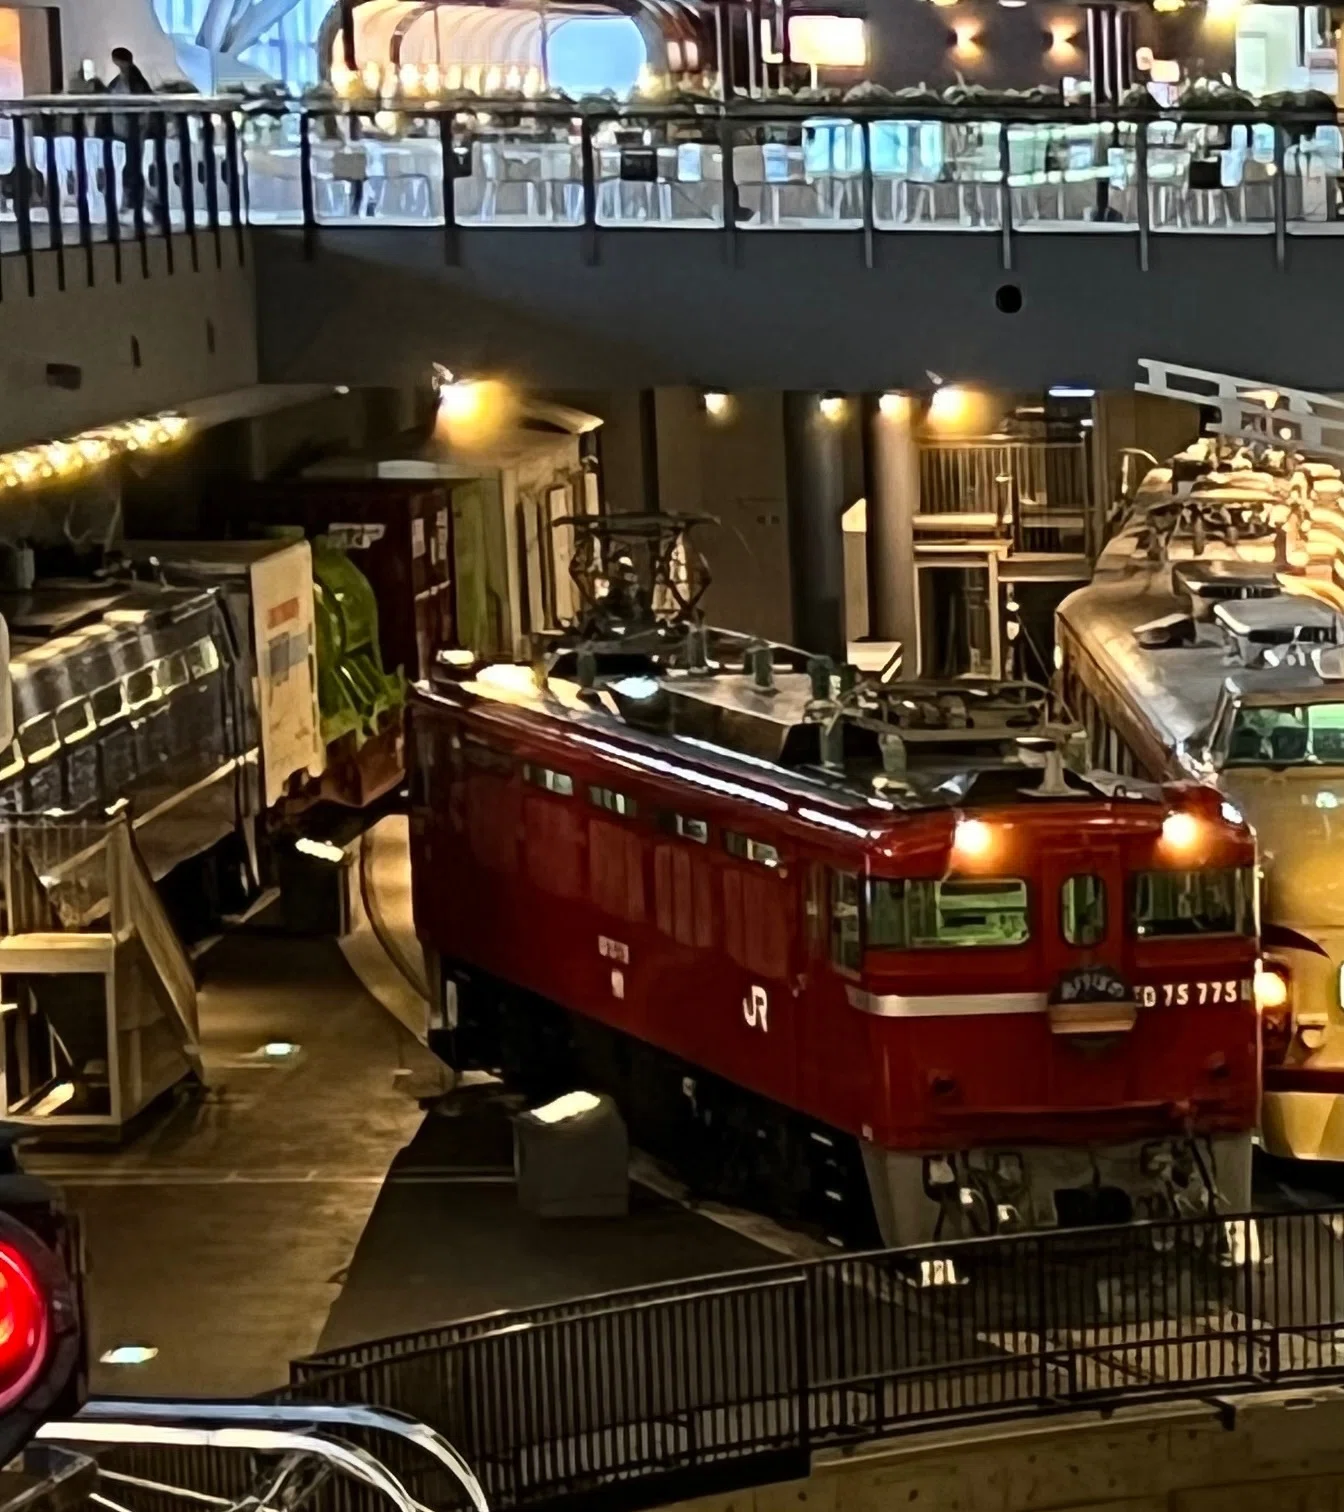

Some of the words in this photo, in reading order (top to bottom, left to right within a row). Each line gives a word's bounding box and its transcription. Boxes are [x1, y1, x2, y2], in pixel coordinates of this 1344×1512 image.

[742, 984, 769, 1034] JR
[1163, 982, 1190, 1007] 75
[1196, 980, 1238, 1005] 775
